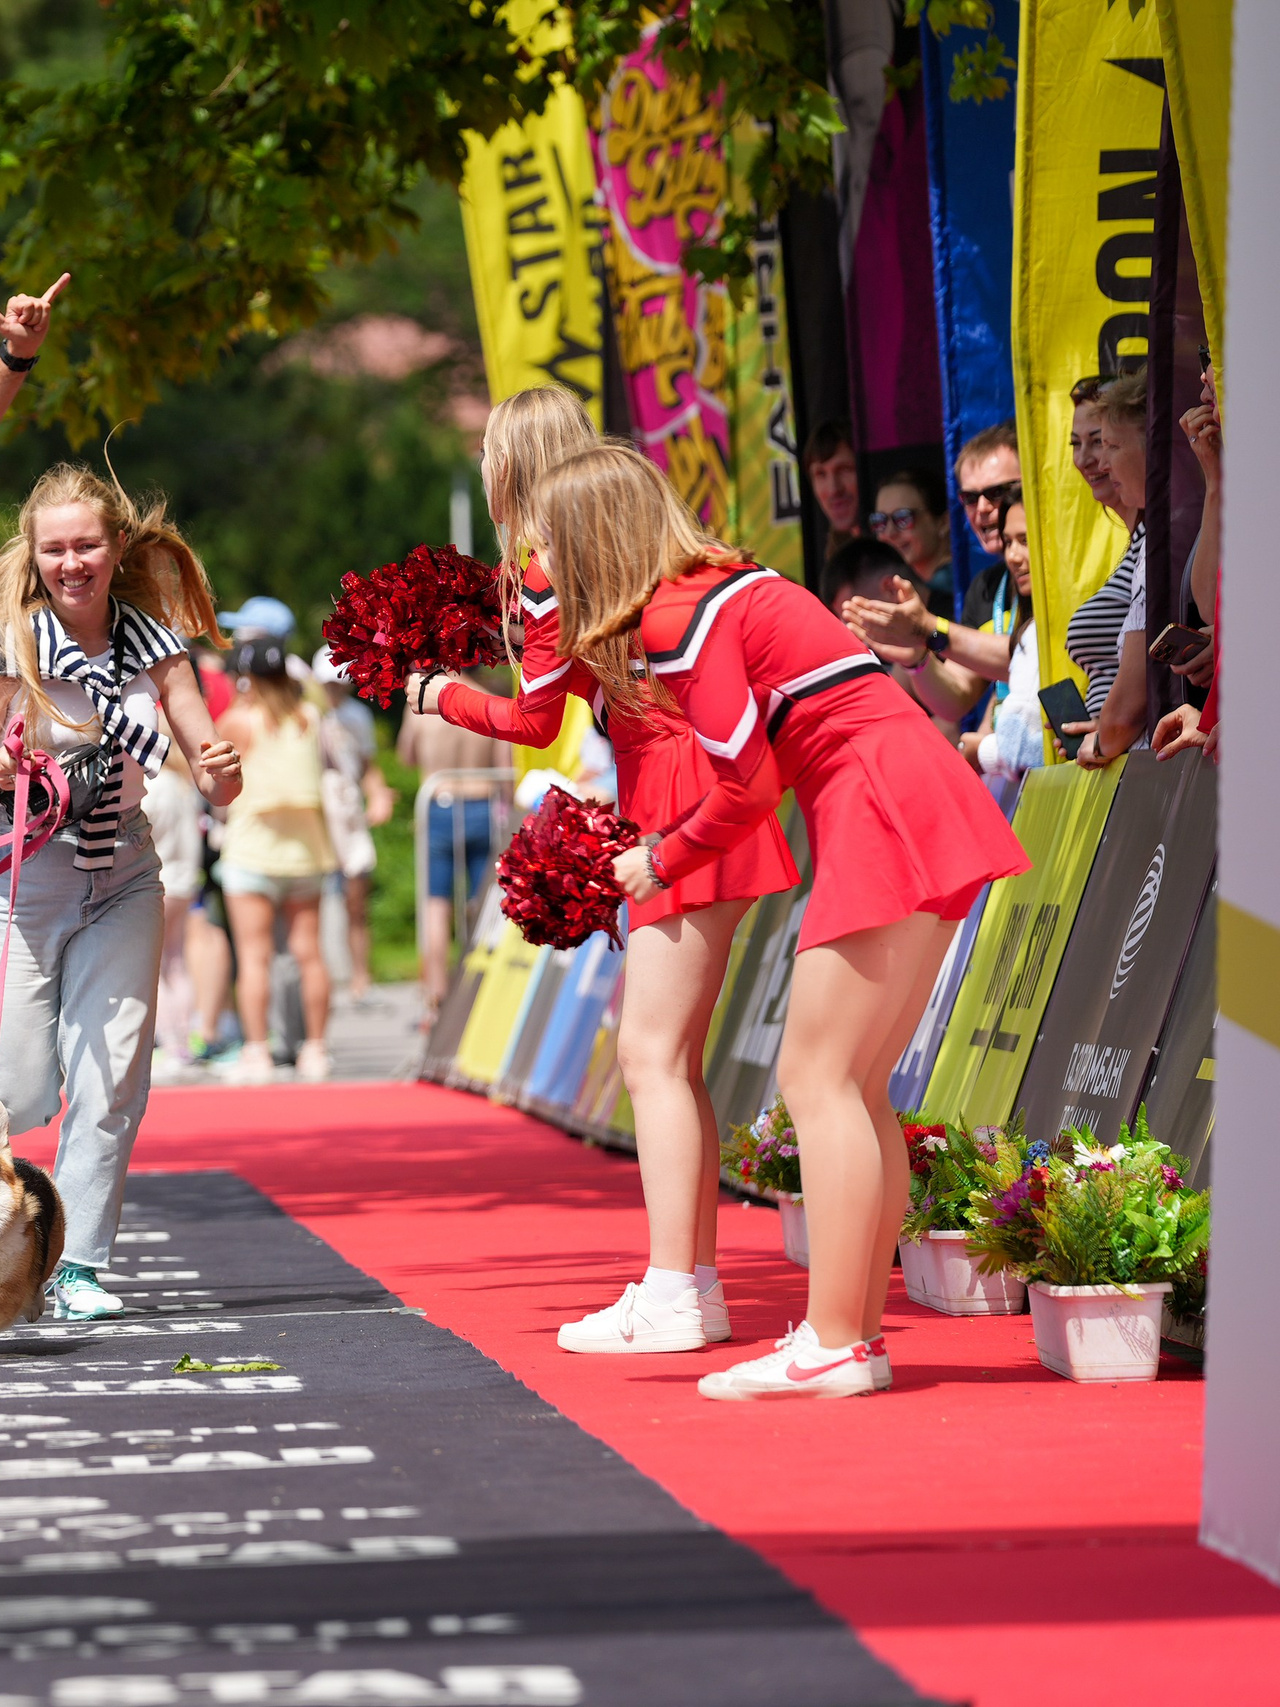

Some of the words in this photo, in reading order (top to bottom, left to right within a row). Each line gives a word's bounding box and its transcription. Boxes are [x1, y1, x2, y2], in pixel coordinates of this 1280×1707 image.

[501, 149, 563, 320] STAR
[22, 1535, 459, 1571] STAR
[52, 1664, 582, 1707] STAR
